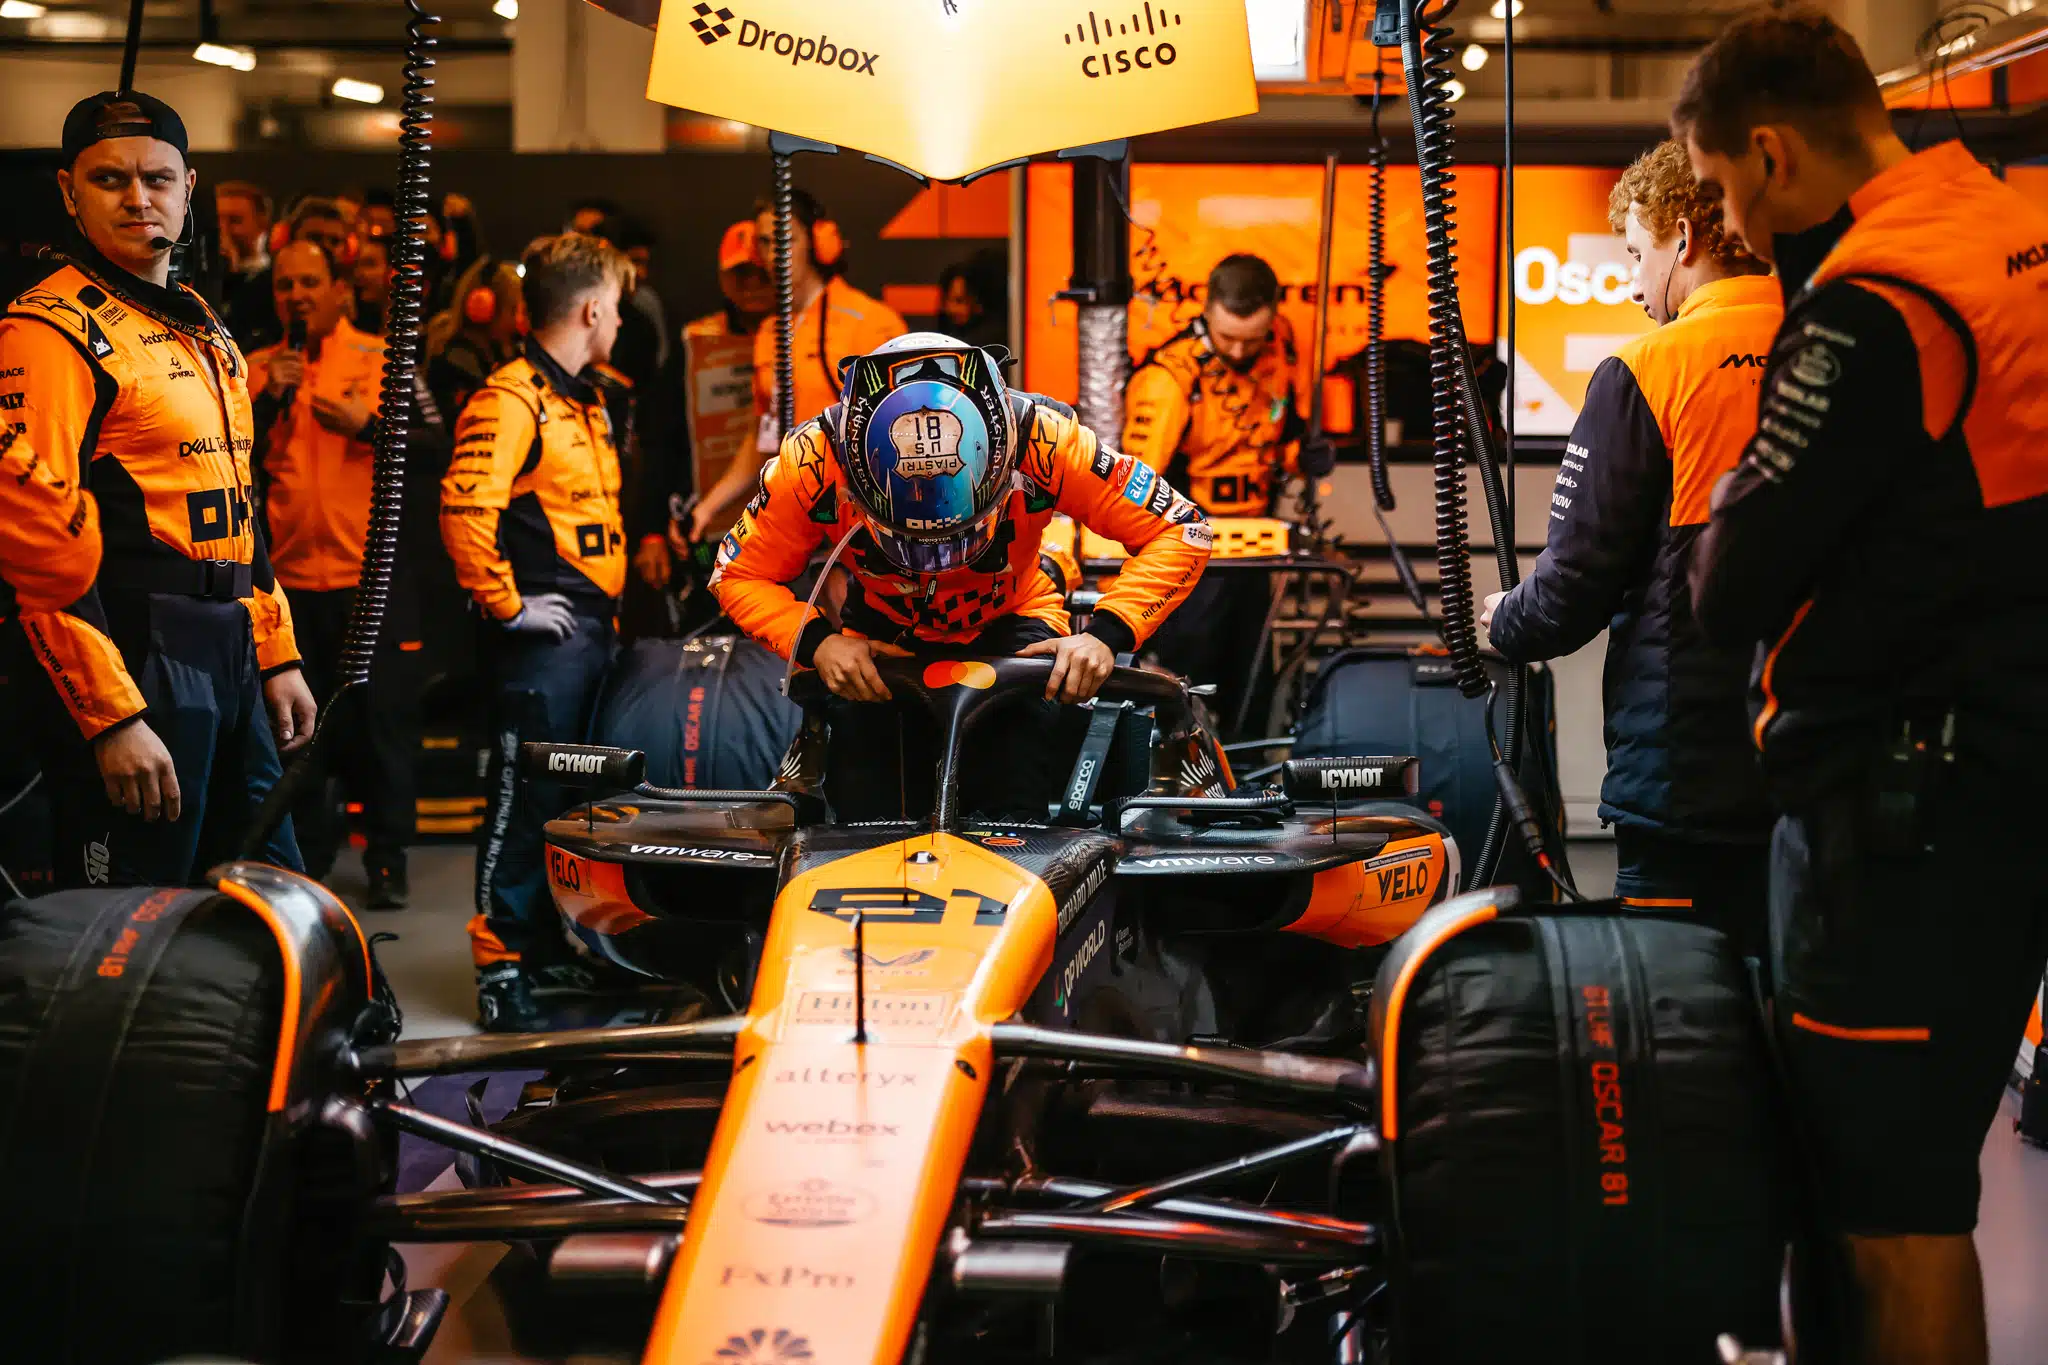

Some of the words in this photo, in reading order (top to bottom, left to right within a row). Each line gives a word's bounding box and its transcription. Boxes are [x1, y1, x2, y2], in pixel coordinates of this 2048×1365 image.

[737, 19, 880, 76] Dropbox
[1081, 42, 1177, 78] CISCO
[138, 329, 176, 347] Android
[168, 372, 178, 380] DP
[179, 437, 217, 457] DELL
[902, 456, 958, 472] PIASTRI
[1141, 587, 1179, 621] RICHARD
[1178, 558, 1201, 588] MILLE
[548, 752, 607, 774] ICYHOT
[1069, 759, 1095, 811] sparco
[1320, 767, 1383, 789] ICYHOT
[630, 844, 755, 862] vmware
[1136, 854, 1276, 868] vmware
[1377, 860, 1429, 904] VELO
[1057, 883, 1087, 936] RICHARD
[1086, 858, 1108, 898] MILLE
[1075, 919, 1106, 979] WORLD
[812, 997, 932, 1011] Hiton
[1592, 1061, 1627, 1163] OSCAR
[764, 1118, 901, 1137] webex
[1602, 1171, 1629, 1206] 81
